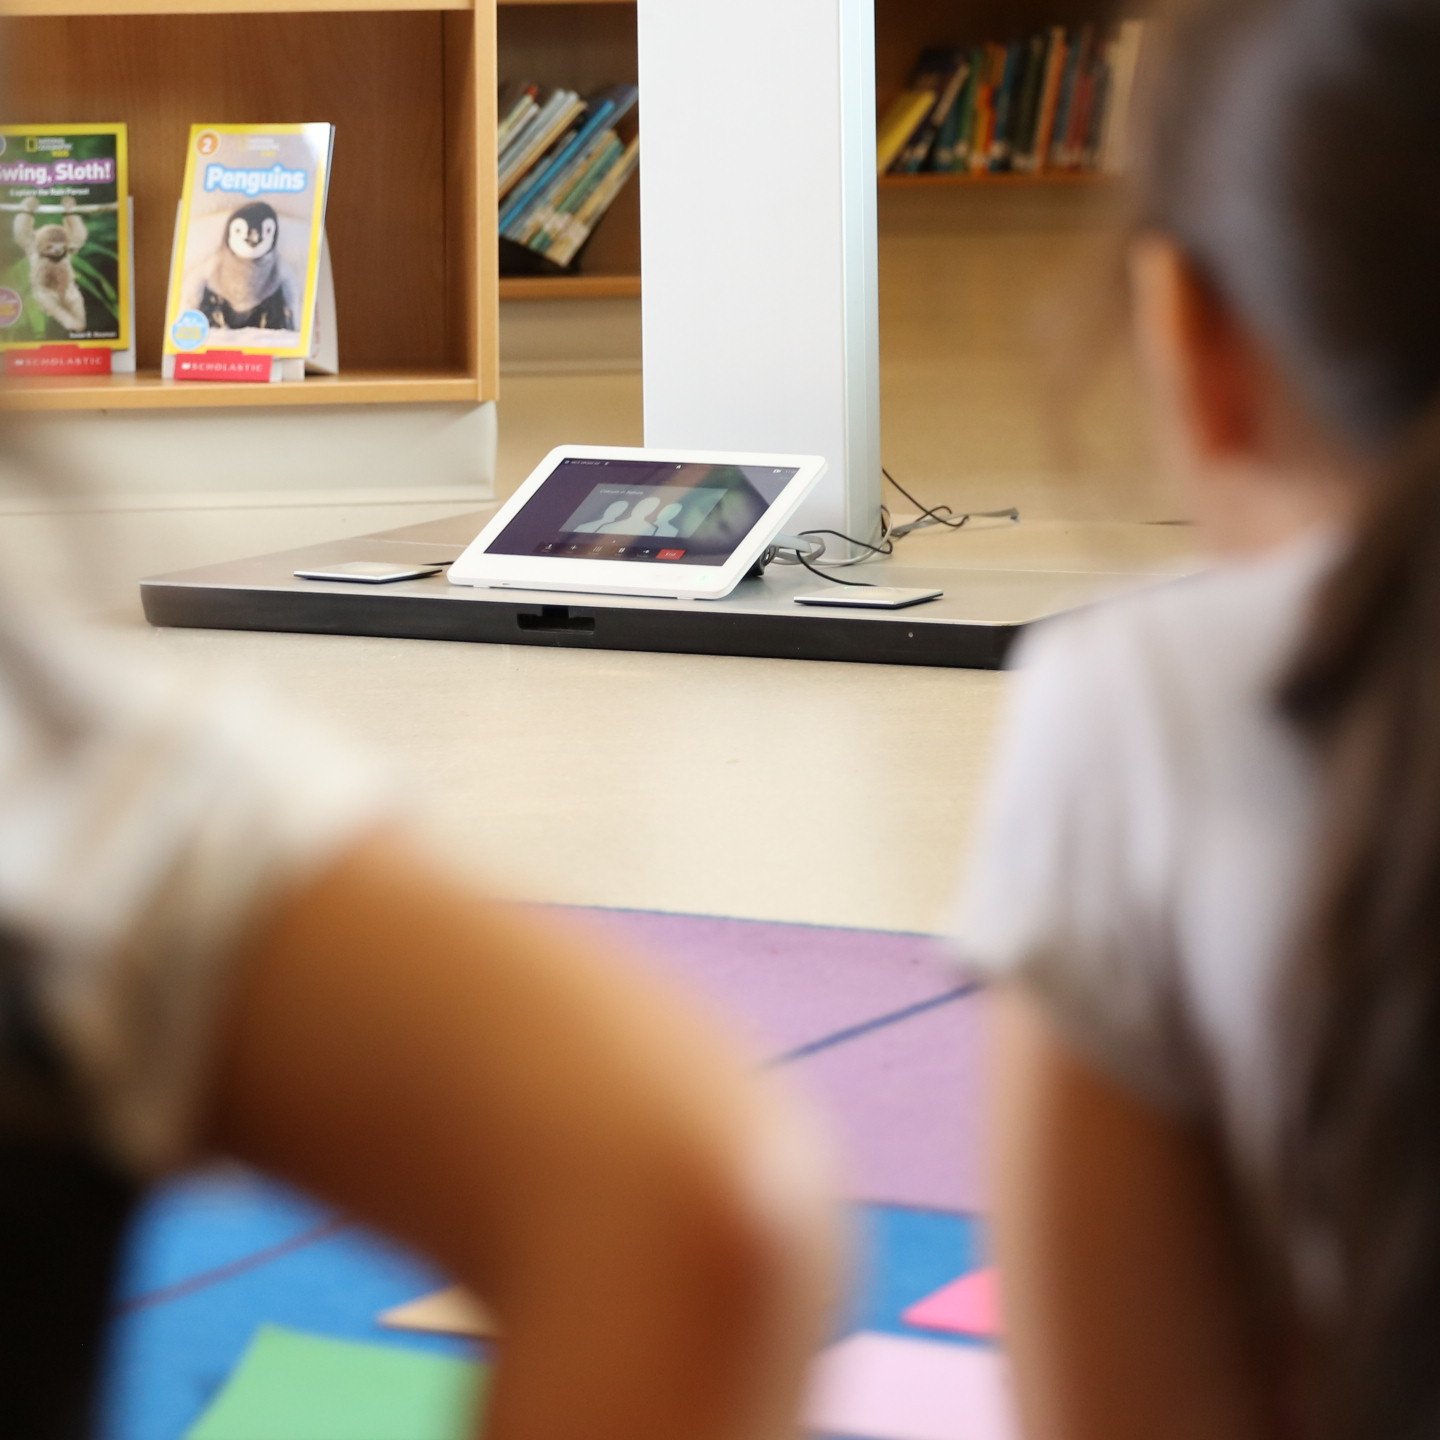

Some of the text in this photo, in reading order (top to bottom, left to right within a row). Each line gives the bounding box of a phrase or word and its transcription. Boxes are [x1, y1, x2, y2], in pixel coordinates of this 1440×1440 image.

[202, 138, 213, 151] 2
[55, 162, 112, 181] Sloth!
[207, 165, 306, 194] Penguins
[191, 362, 264, 373] SCHOLASTIC
